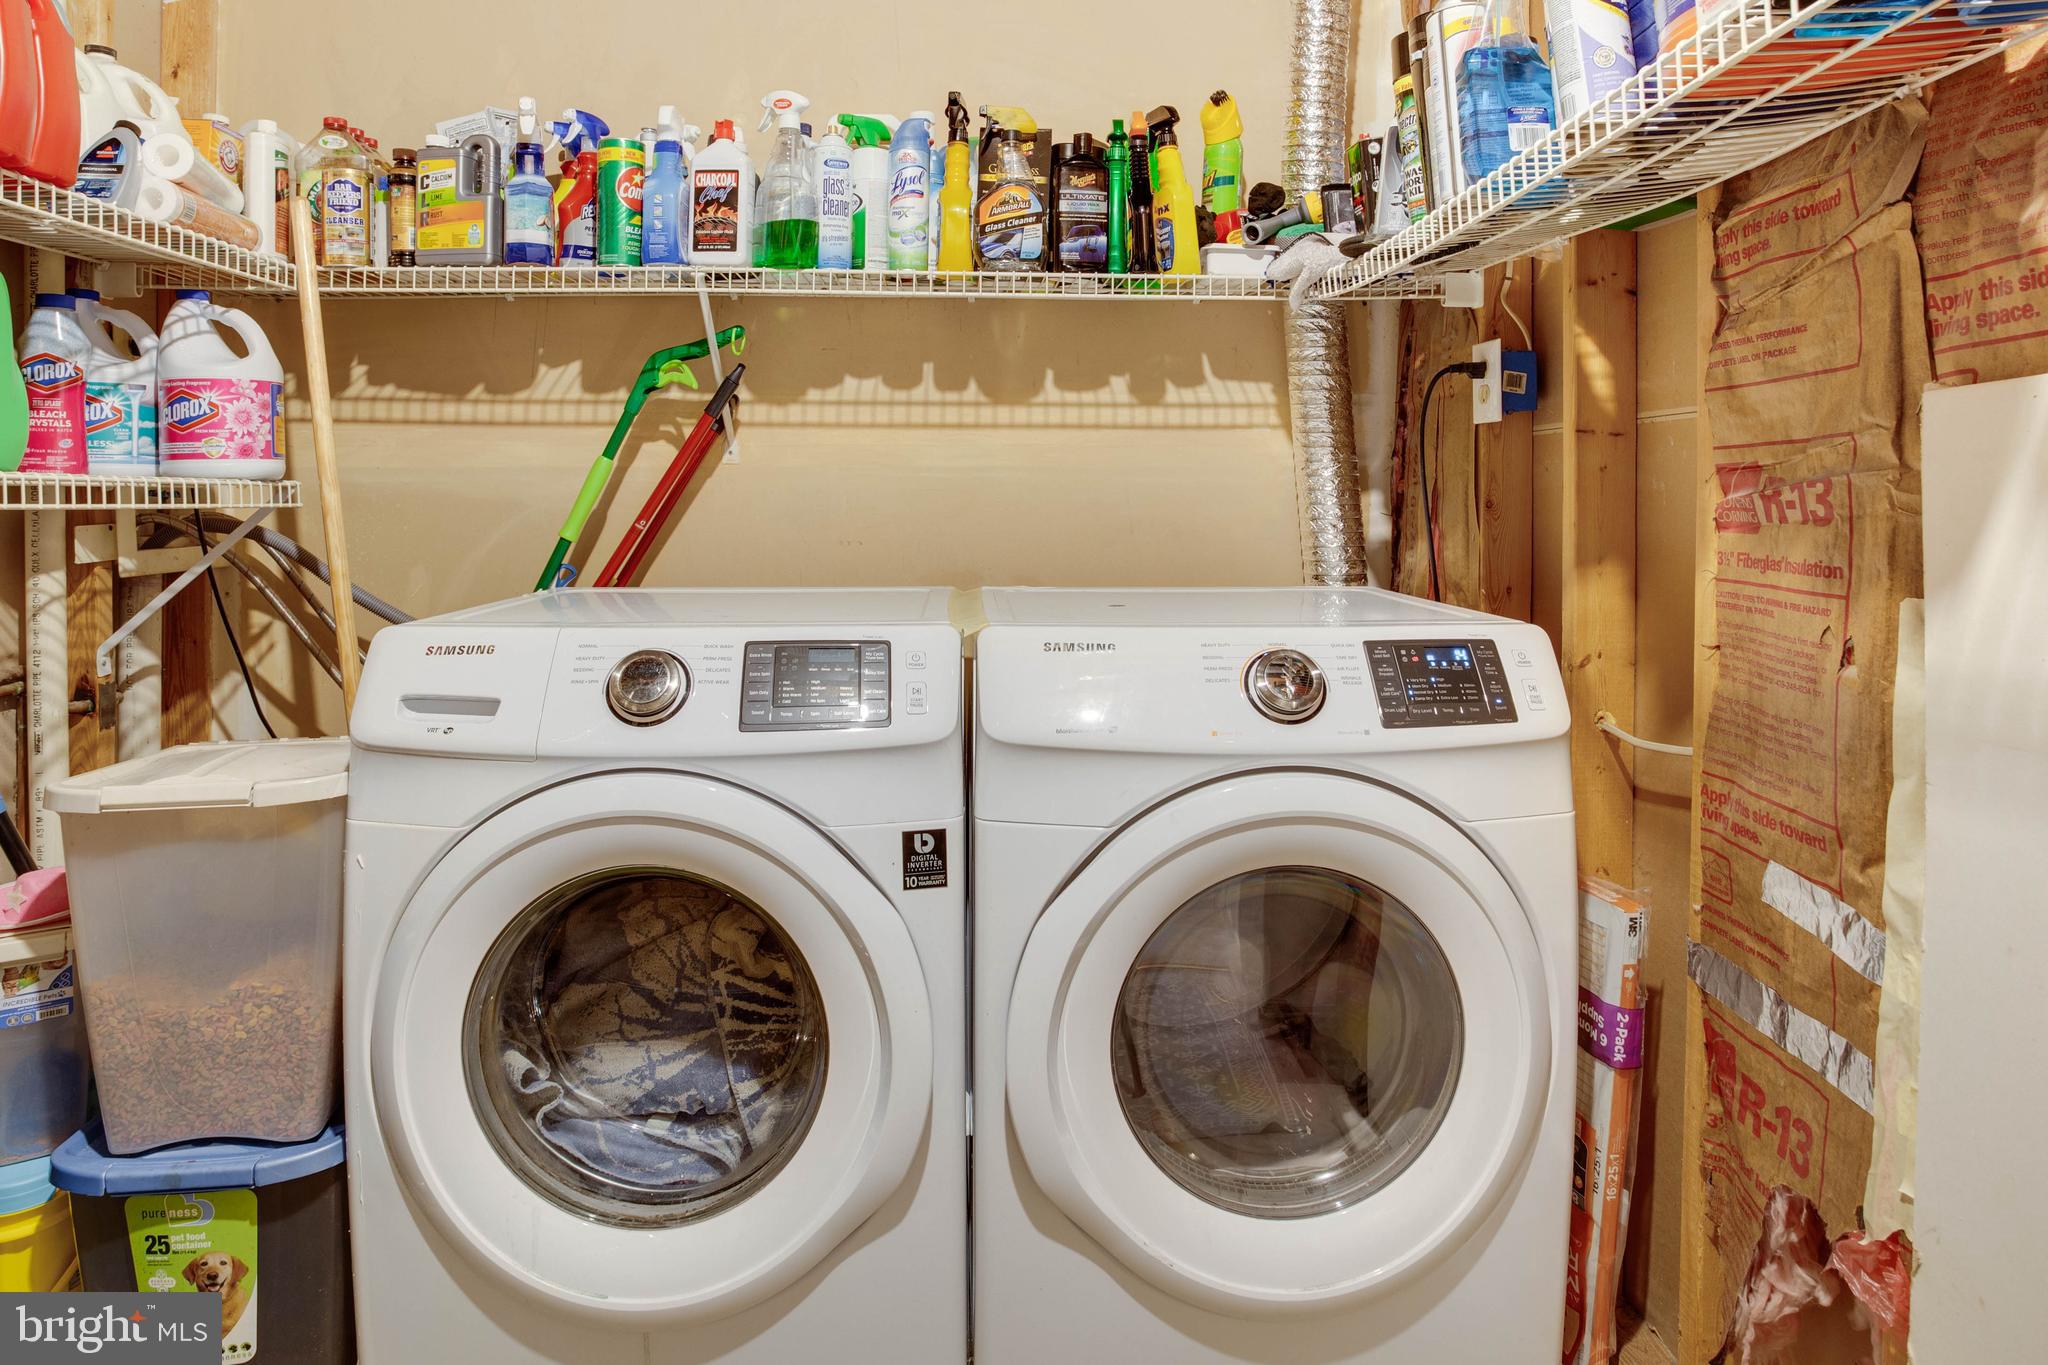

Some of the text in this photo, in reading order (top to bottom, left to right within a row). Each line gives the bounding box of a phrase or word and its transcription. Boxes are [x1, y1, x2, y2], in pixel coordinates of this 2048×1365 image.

[1998, 116, 2048, 136] statemen
[431, 173, 453, 182] CALCIUM
[695, 173, 737, 187] CHARCOAL
[890, 170, 927, 197] Lysol
[334, 183, 352, 191] BAR
[699, 183, 734, 204] Chef
[822, 176, 845, 199] glass
[430, 193, 443, 201] LIME
[1061, 193, 1105, 201] ULTIMATE
[326, 216, 364, 226] CLEANSER
[985, 215, 1037, 233] Glass Cleaner
[1717, 187, 1841, 249] pply this side toward
[1927, 264, 2048, 315] Apply this sid
[1975, 302, 2041, 332] space.
[1756, 324, 1808, 342] PERFORMANCE
[1708, 357, 1737, 369] OMPLETE
[1762, 345, 1797, 360] PACKAGE
[162, 397, 211, 425] CLOROX
[29, 419, 72, 428] RYSTALS
[1716, 509, 1758, 523] CORNING
[1784, 557, 1844, 579] Insulation
[1802, 605, 1832, 617] HAZARD
[425, 644, 496, 656] SAMSUNG
[1044, 642, 1117, 653] SAMSUNG
[33, 649, 41, 668] 4112
[34, 689, 42, 728] CHARLOTTE
[1752, 808, 1777, 831] side
[1779, 819, 1828, 854] toward
[907, 860, 943, 869] INVERTER
[911, 854, 938, 862] DIGITAL
[904, 876, 918, 888] 10
[1628, 916, 1639, 938] 3M
[1578, 1001, 1605, 1029] Suppl
[1599, 1033, 1608, 1047] 6
[1613, 1012, 1630, 1063] 2-Pack
[1737, 1072, 1813, 1180] R-13
[1606, 1154, 1620, 1201] 16x25x1
[144, 1234, 171, 1255] 25
[171, 1232, 206, 1243] pet food
[171, 1241, 211, 1250] container
